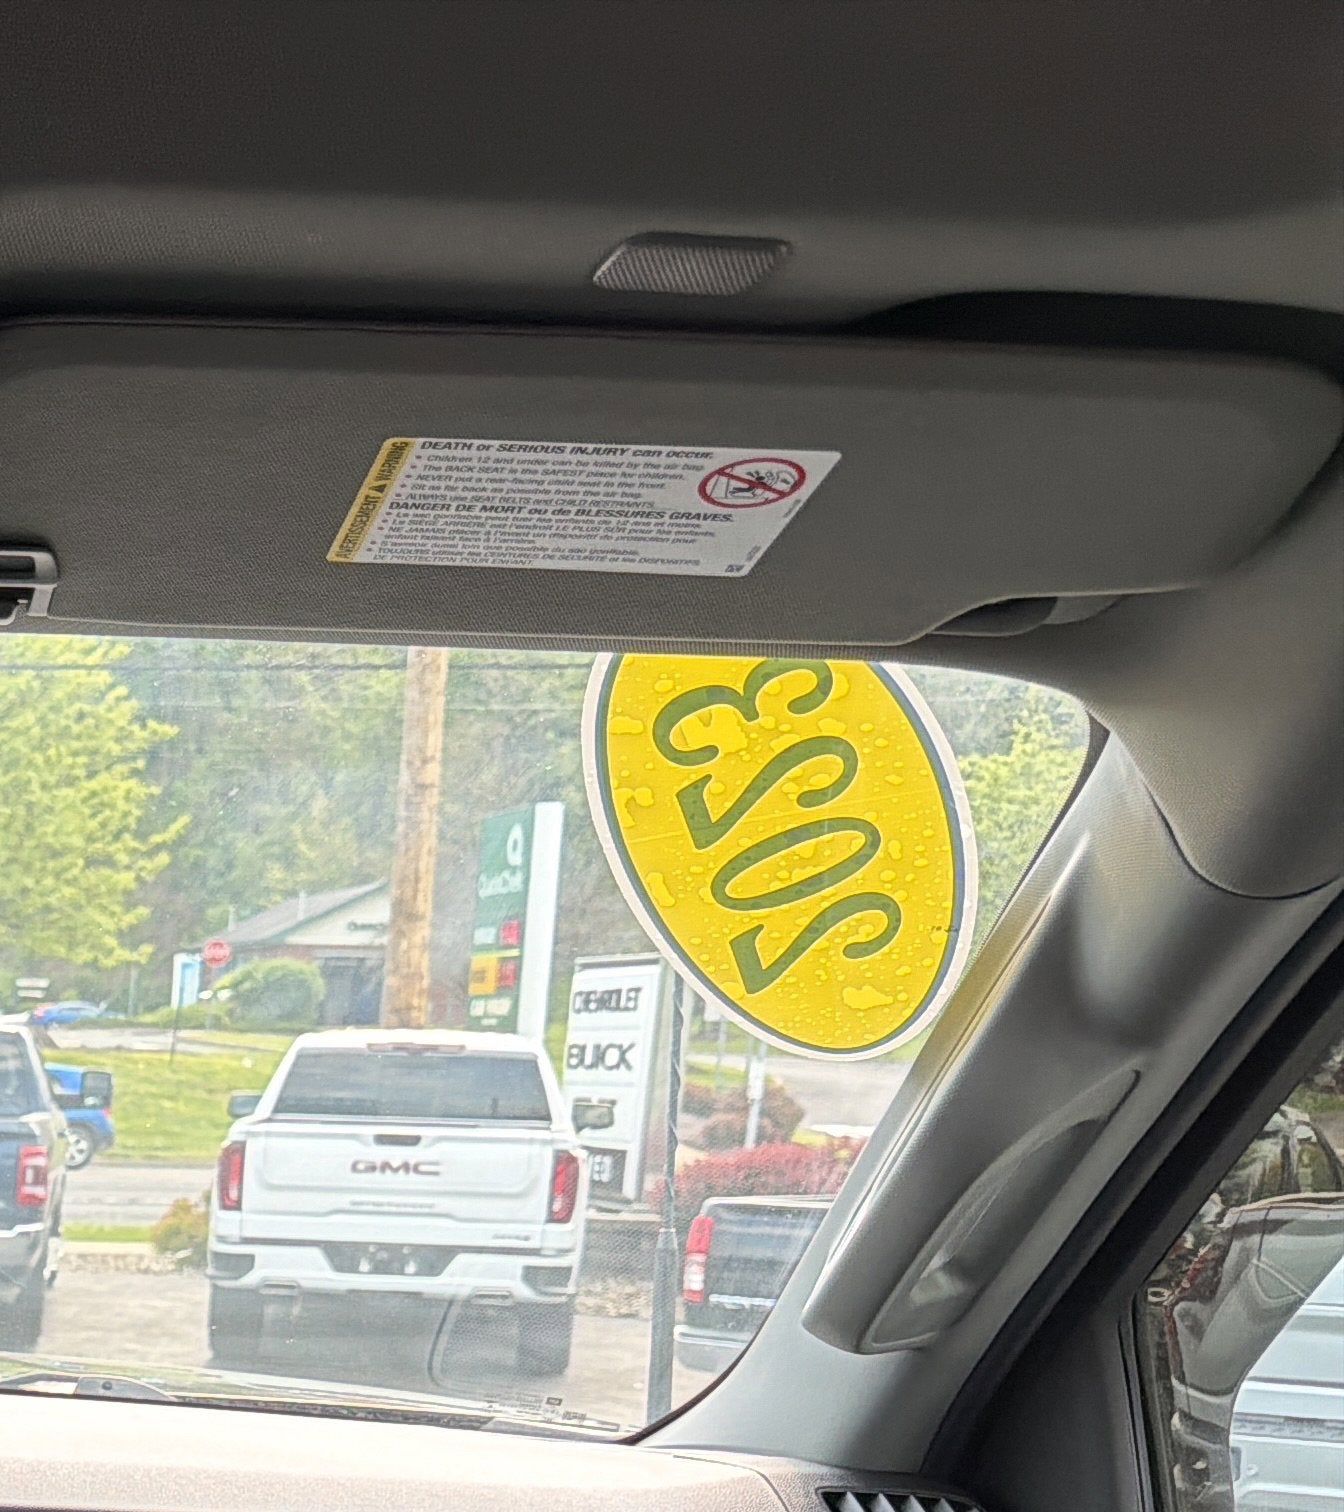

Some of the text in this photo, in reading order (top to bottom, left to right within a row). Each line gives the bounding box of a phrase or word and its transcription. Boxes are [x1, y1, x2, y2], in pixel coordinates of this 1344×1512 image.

[419, 441, 717, 459] DEATH or SERIOUS INJURY can occur.
[377, 442, 409, 484] WARNING
[387, 501, 738, 522] DANGER DE MORT ou de BLESSURES GRAVES.
[568, 1043, 635, 1071] BUICK
[351, 1160, 440, 1176] GMC
